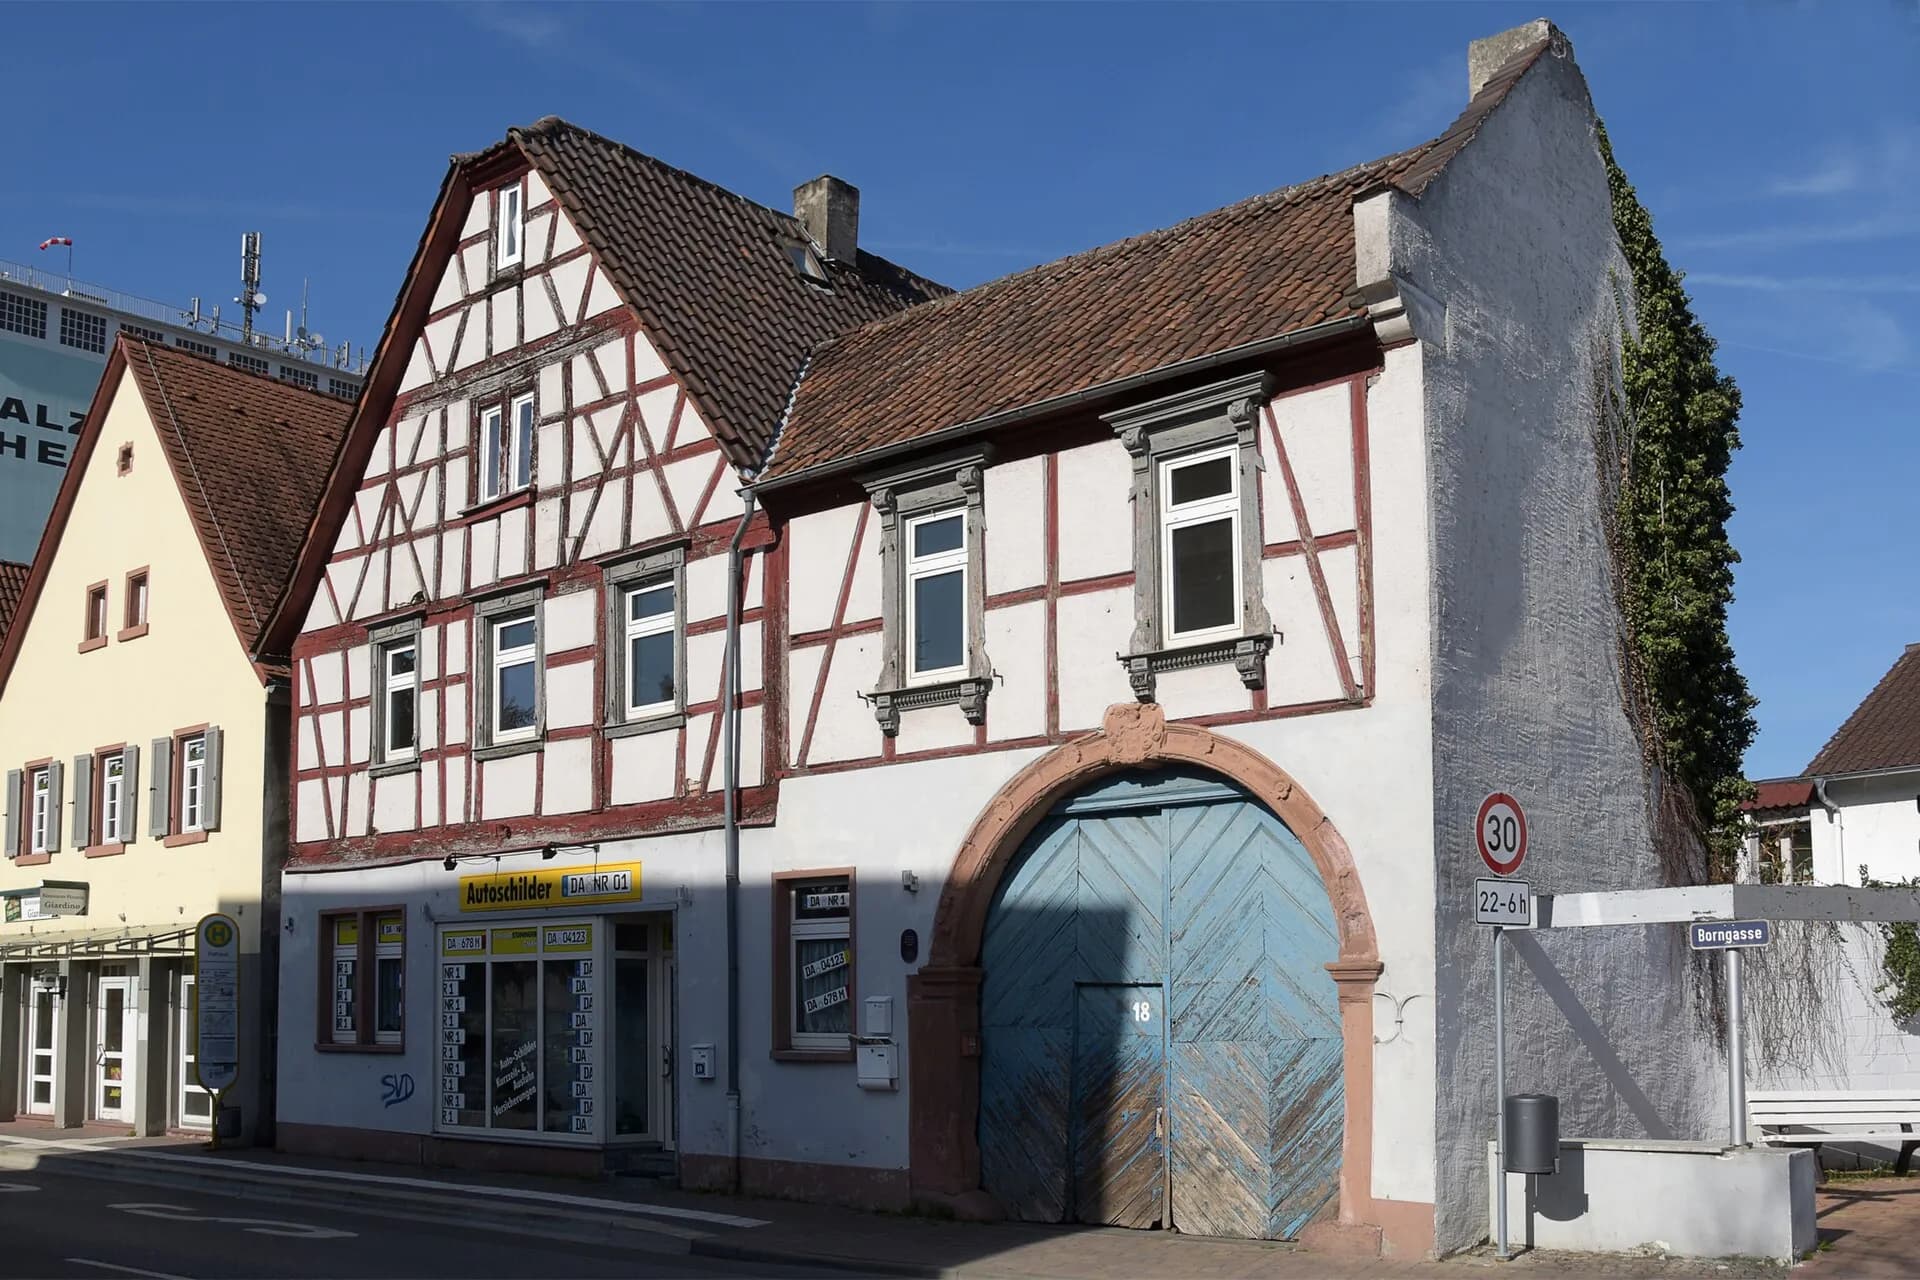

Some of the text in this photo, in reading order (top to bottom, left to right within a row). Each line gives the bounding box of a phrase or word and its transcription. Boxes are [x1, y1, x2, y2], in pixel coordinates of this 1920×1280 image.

[1487, 815, 1516, 852] 30
[467, 873, 629, 904] Autoschilder DA NR 01
[44, 901, 81, 909] Giardino
[810, 896, 820, 906] DA
[547, 933, 557, 944] DA
[562, 931, 586, 943] 04123
[1697, 928, 1762, 944] Borngasse
[447, 938, 457, 949] DA
[805, 953, 845, 977] DA 04123
[576, 980, 586, 992] DA
[807, 1000, 818, 1011] DA
[1132, 1001, 1150, 1022] 18
[576, 1014, 586, 1027] DA
[576, 1049, 586, 1062] DA
[576, 1084, 586, 1096] DA
[576, 1118, 586, 1130] DA
